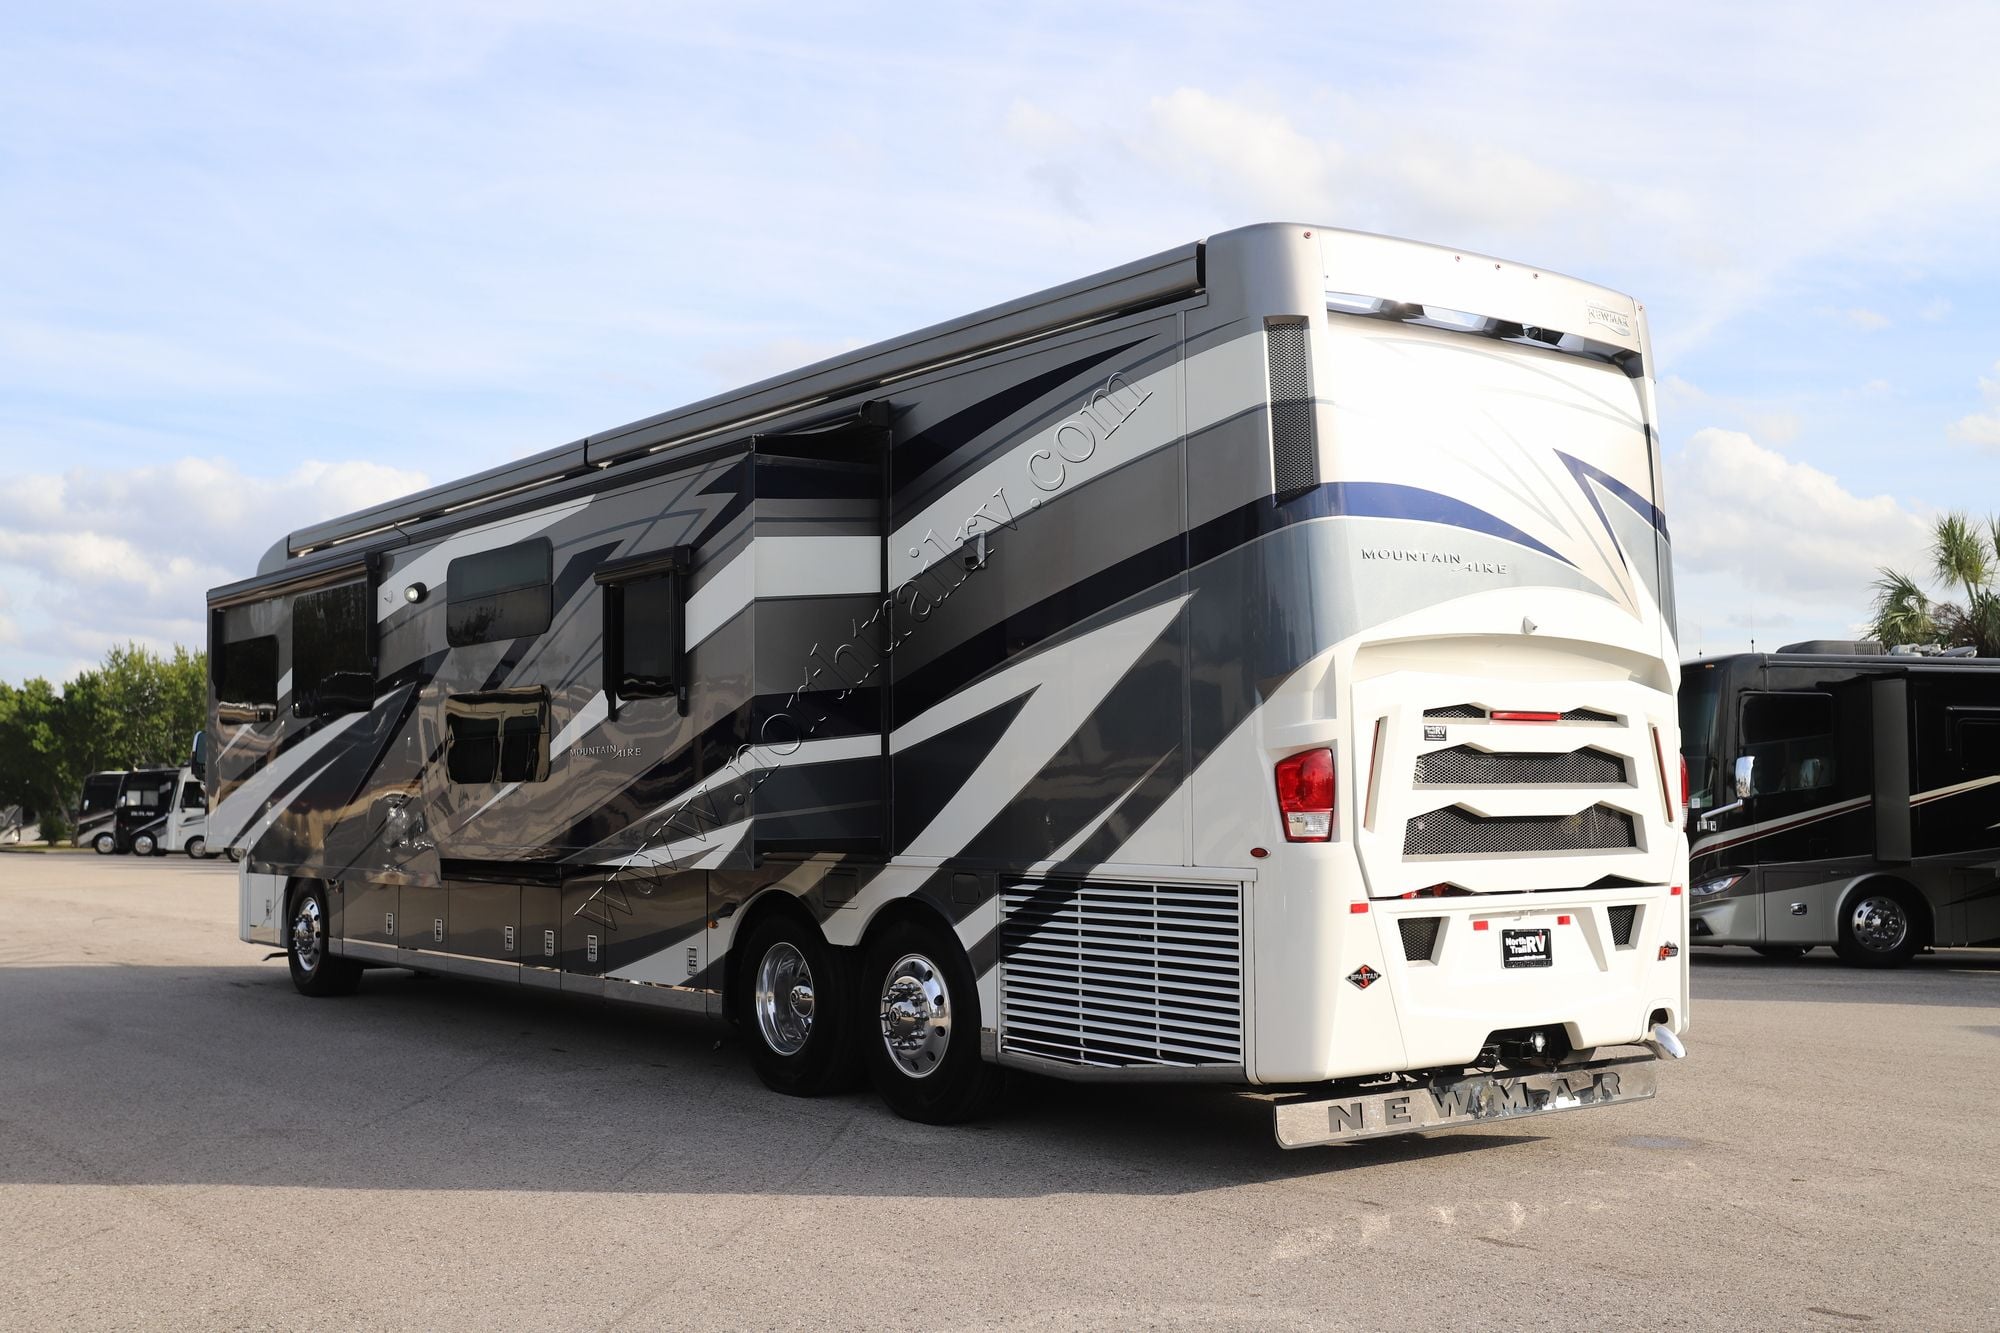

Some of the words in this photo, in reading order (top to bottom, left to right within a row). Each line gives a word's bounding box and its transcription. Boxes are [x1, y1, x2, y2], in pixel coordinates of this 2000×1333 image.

[1587, 308, 1629, 328] NEWMAR
[1361, 548, 1461, 564] MOUNTAIN
[1451, 561, 1508, 575] AIRE
[569, 743, 617, 758] MOUNTAIN
[611, 747, 641, 760] AIRE
[1505, 936, 1527, 946] North
[1510, 944, 1528, 954] Trail
[1526, 934, 1546, 953] RV
[1350, 972, 1379, 981] SPARTAN
[1327, 1072, 1621, 1134] NEWMAR
